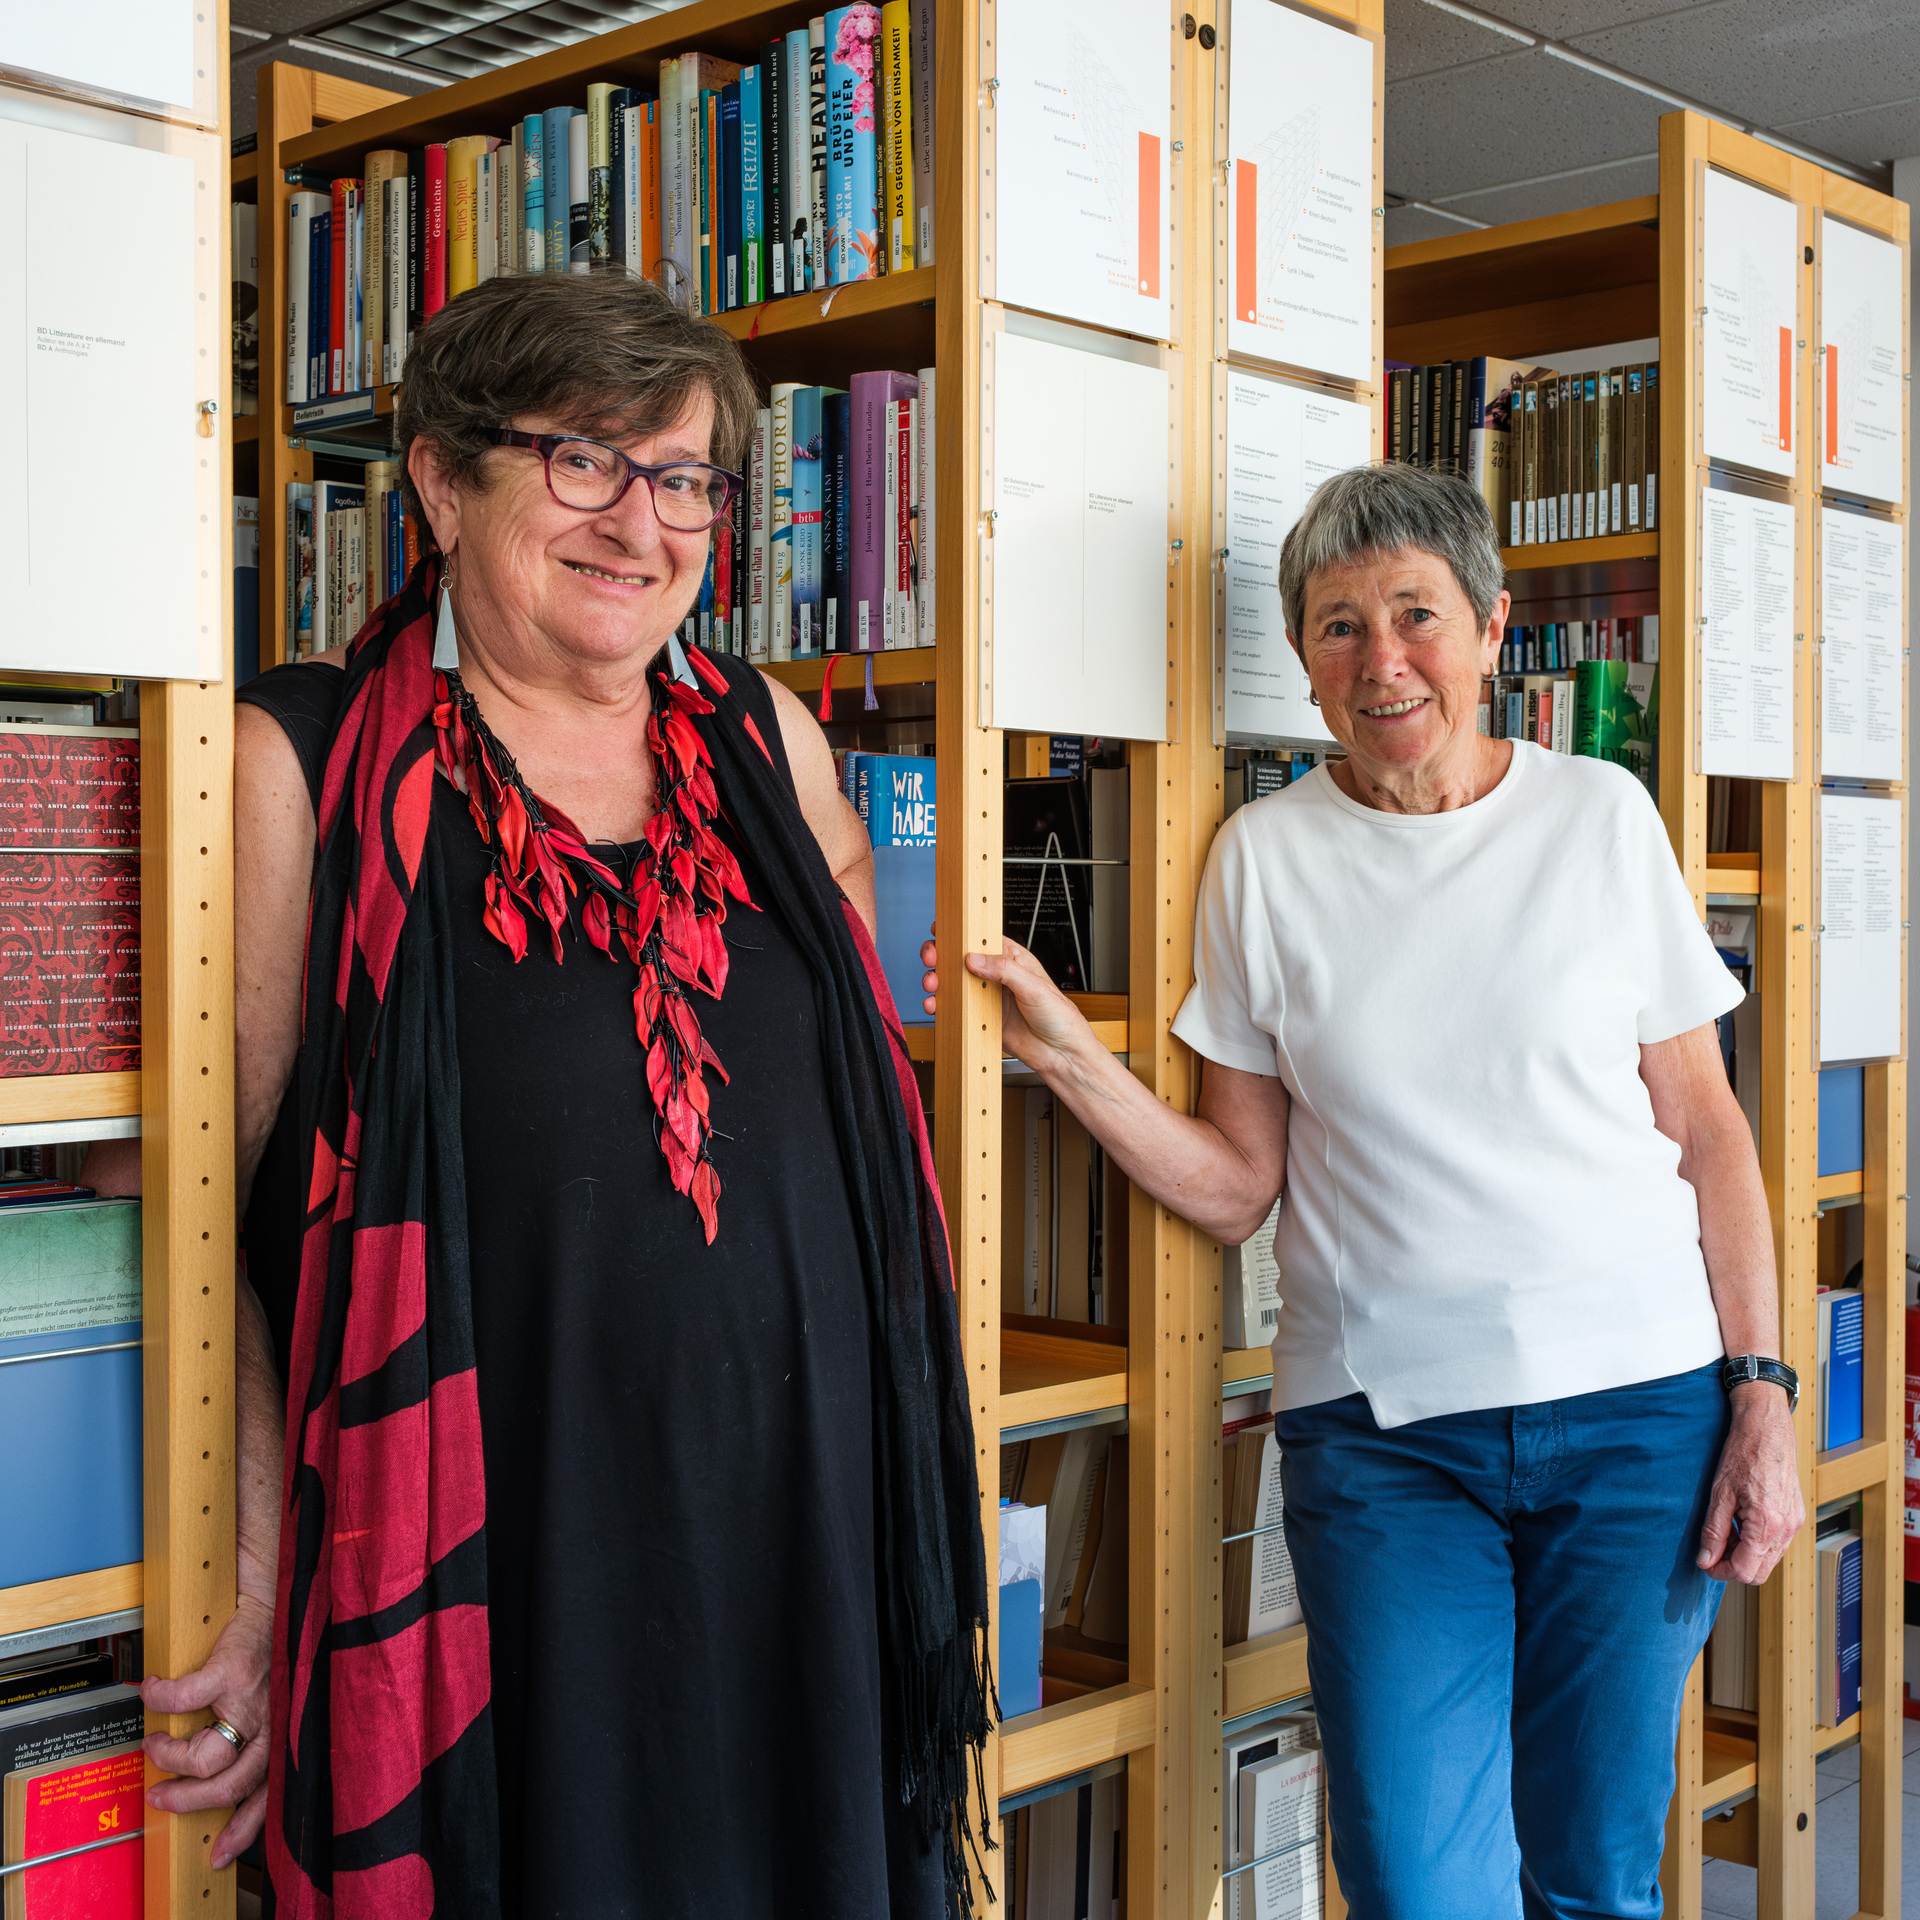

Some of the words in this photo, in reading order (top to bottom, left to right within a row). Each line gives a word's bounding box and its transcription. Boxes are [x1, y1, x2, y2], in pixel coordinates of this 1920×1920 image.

[921, 7, 929, 42] Keegan
[893, 28, 901, 96] EINSAMKEIT
[772, 80, 777, 91] im
[1034, 80, 1061, 93] Belletristik
[810, 46, 827, 173] HEAVEN
[843, 78, 853, 120] EIER
[1044, 105, 1070, 118] Belletristik
[675, 128, 682, 138] du
[830, 90, 842, 162] BRÜSTE
[844, 128, 854, 168] UND
[924, 135, 929, 147] im
[1054, 135, 1080, 148] Belletristik
[532, 133, 541, 178] LADEN
[1066, 170, 1093, 182] Belletristik
[433, 179, 442, 238] Geschichte
[1080, 208, 1106, 221] Belletristik
[817, 255, 822, 268] BD
[1096, 252, 1122, 264] Belletristik
[37, 326, 47, 334] BD
[49, 328, 84, 340] Littérature
[95, 336, 126, 346] allemand
[54, 347, 88, 358] Anthologies
[920, 381, 928, 425] überhaupt
[296, 408, 324, 421] Belletristik
[753, 428, 764, 464] Notablen
[867, 433, 872, 442] in
[1492, 441, 1504, 453] 20
[774, 396, 787, 524] EUPHORIA
[1492, 456, 1503, 468] 40
[752, 465, 763, 480] des
[920, 466, 928, 502] Damals,
[752, 482, 763, 516] Geliebte
[752, 518, 762, 531] Die
[798, 514, 814, 523] btb
[751, 547, 765, 604] Khoury-Ghata
[1529, 688, 1537, 717] reisen
[892, 771, 924, 801] WiR
[892, 802, 936, 836] hABE
[18, 1302, 52, 1310] europäischer
[54, 1297, 94, 1306] Familienroman
[69, 1307, 87, 1315] ewigen
[89, 1303, 114, 1313] Frühlings,
[116, 1300, 140, 1310] Teneriffa
[57, 1322, 72, 1330] immer
[88, 1318, 112, 1326] Pförtner.
[15, 1750, 40, 1761] erzählen,
[43, 1746, 52, 1754] auf
[54, 1743, 64, 1751] der
[76, 1733, 106, 1745] Gewißheit
[108, 1728, 124, 1738] lastet,
[126, 1725, 137, 1734] daß
[43, 1737, 61, 1745] davon
[63, 1730, 89, 1741] besessen,
[103, 1721, 120, 1730] Leben
[15, 1760, 37, 1770] Männer
[39, 1755, 48, 1764] mit
[50, 1753, 60, 1761] der
[61, 1748, 84, 1759] gleichen
[85, 1740, 112, 1753] Intensität
[1281, 1779, 1289, 1788] LA
[1290, 1765, 1321, 1785] BIOGRAPHE
[99, 1803, 120, 1831] st
